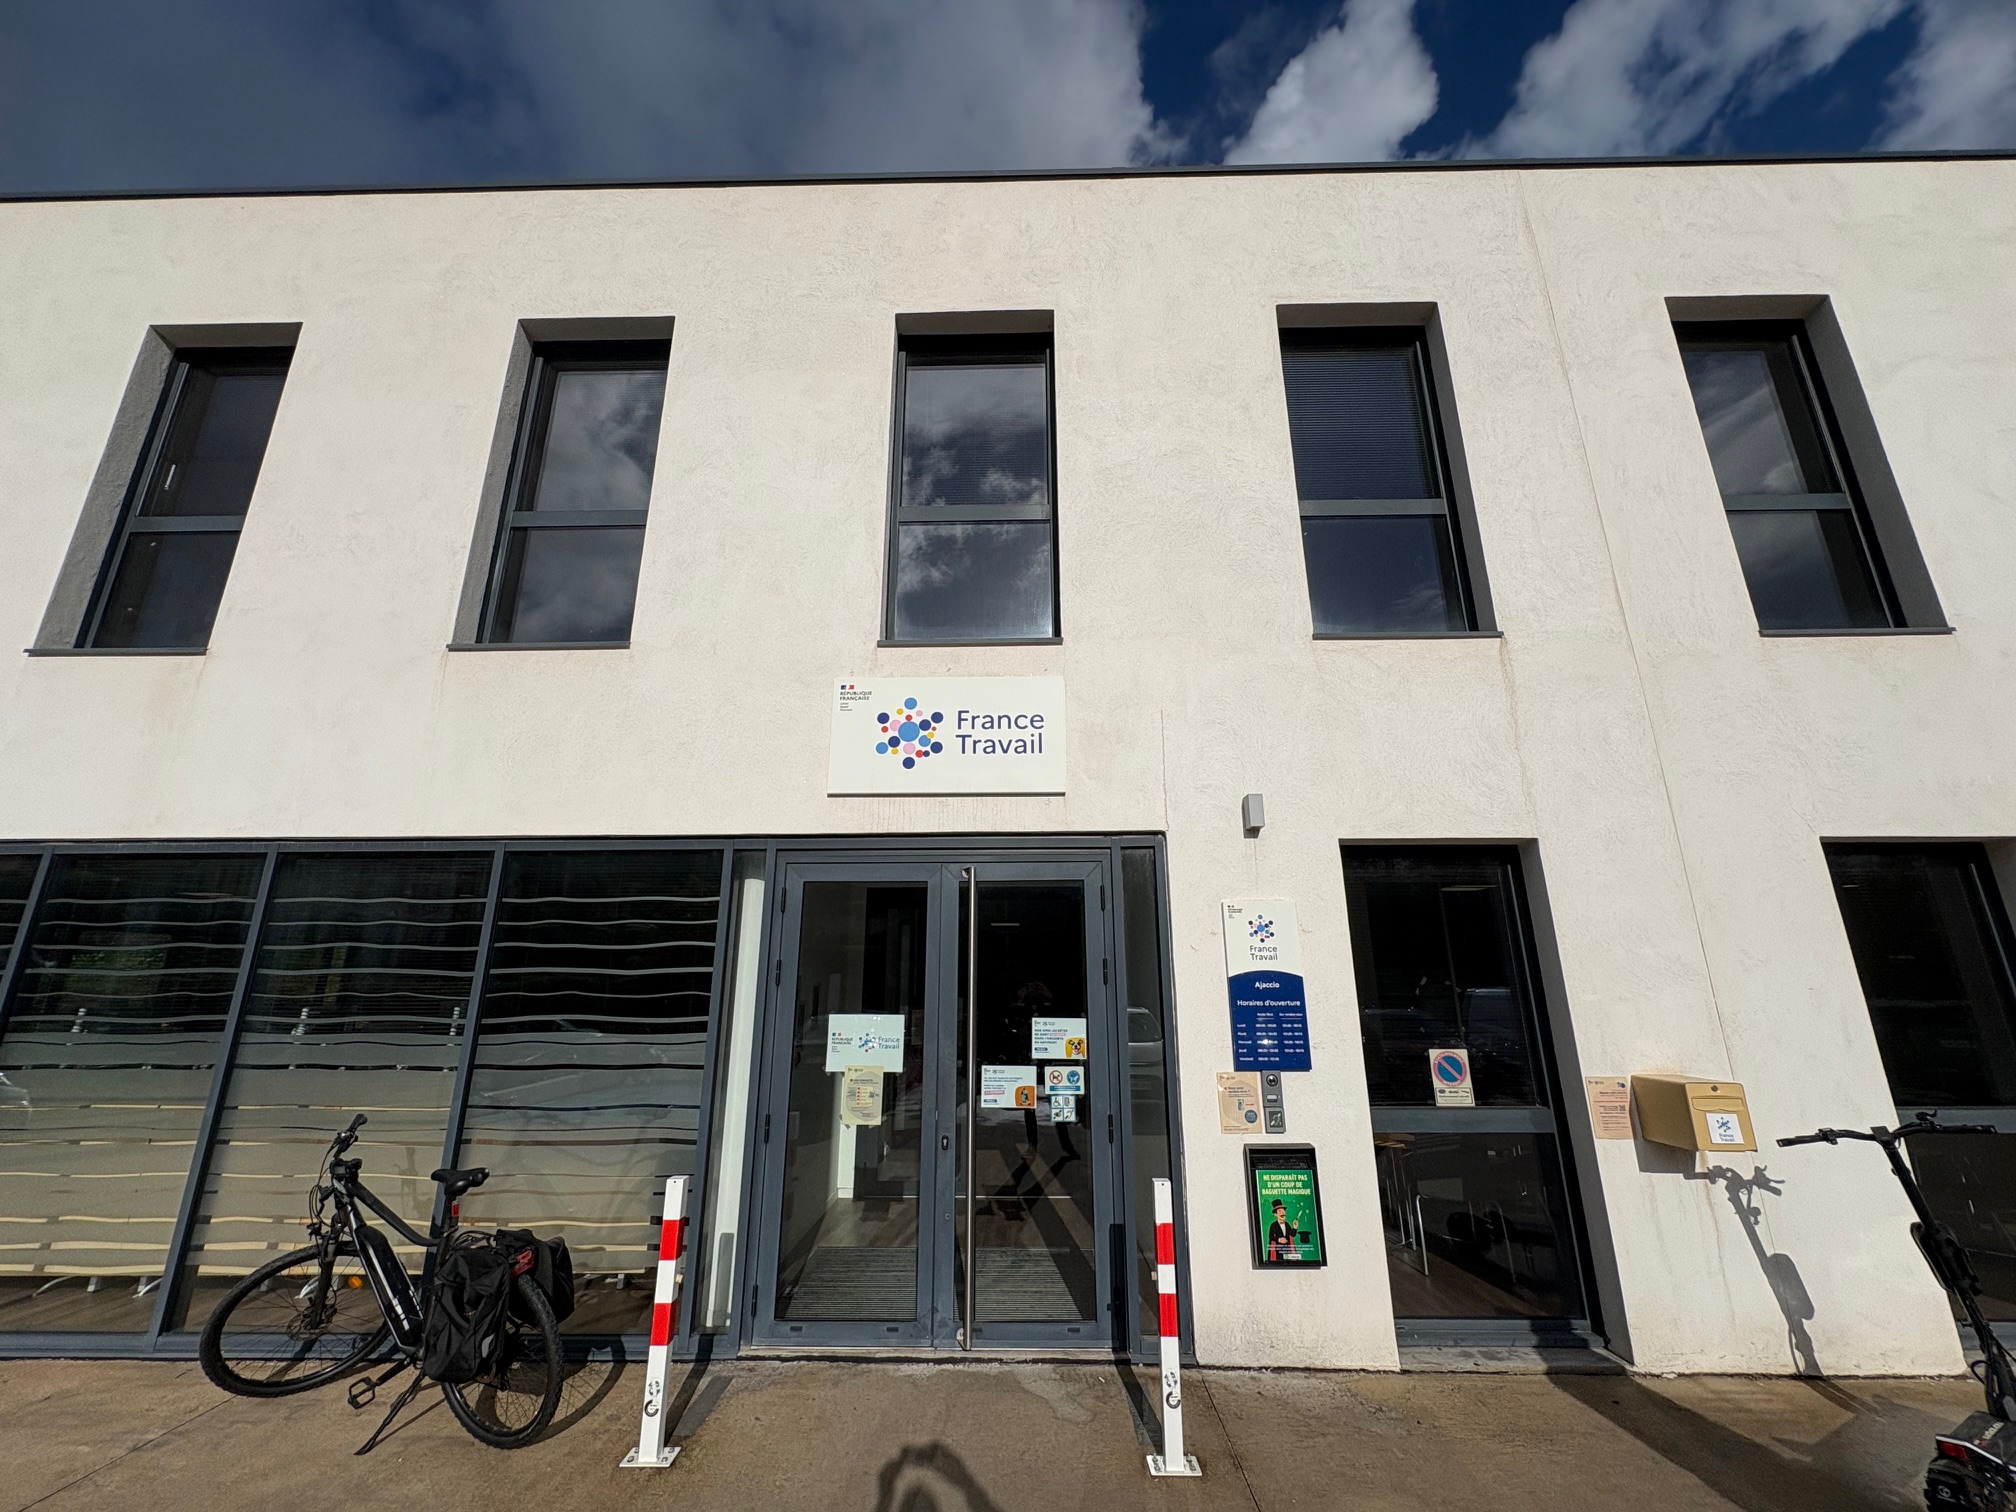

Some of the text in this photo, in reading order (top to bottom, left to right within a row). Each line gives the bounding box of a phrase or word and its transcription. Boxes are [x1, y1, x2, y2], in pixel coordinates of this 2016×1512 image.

[957, 710, 1045, 730] France
[955, 733, 1043, 754] Travail
[1249, 945, 1278, 953] France
[1249, 953, 1278, 961] Travail
[1255, 981, 1280, 989] Ajaccio
